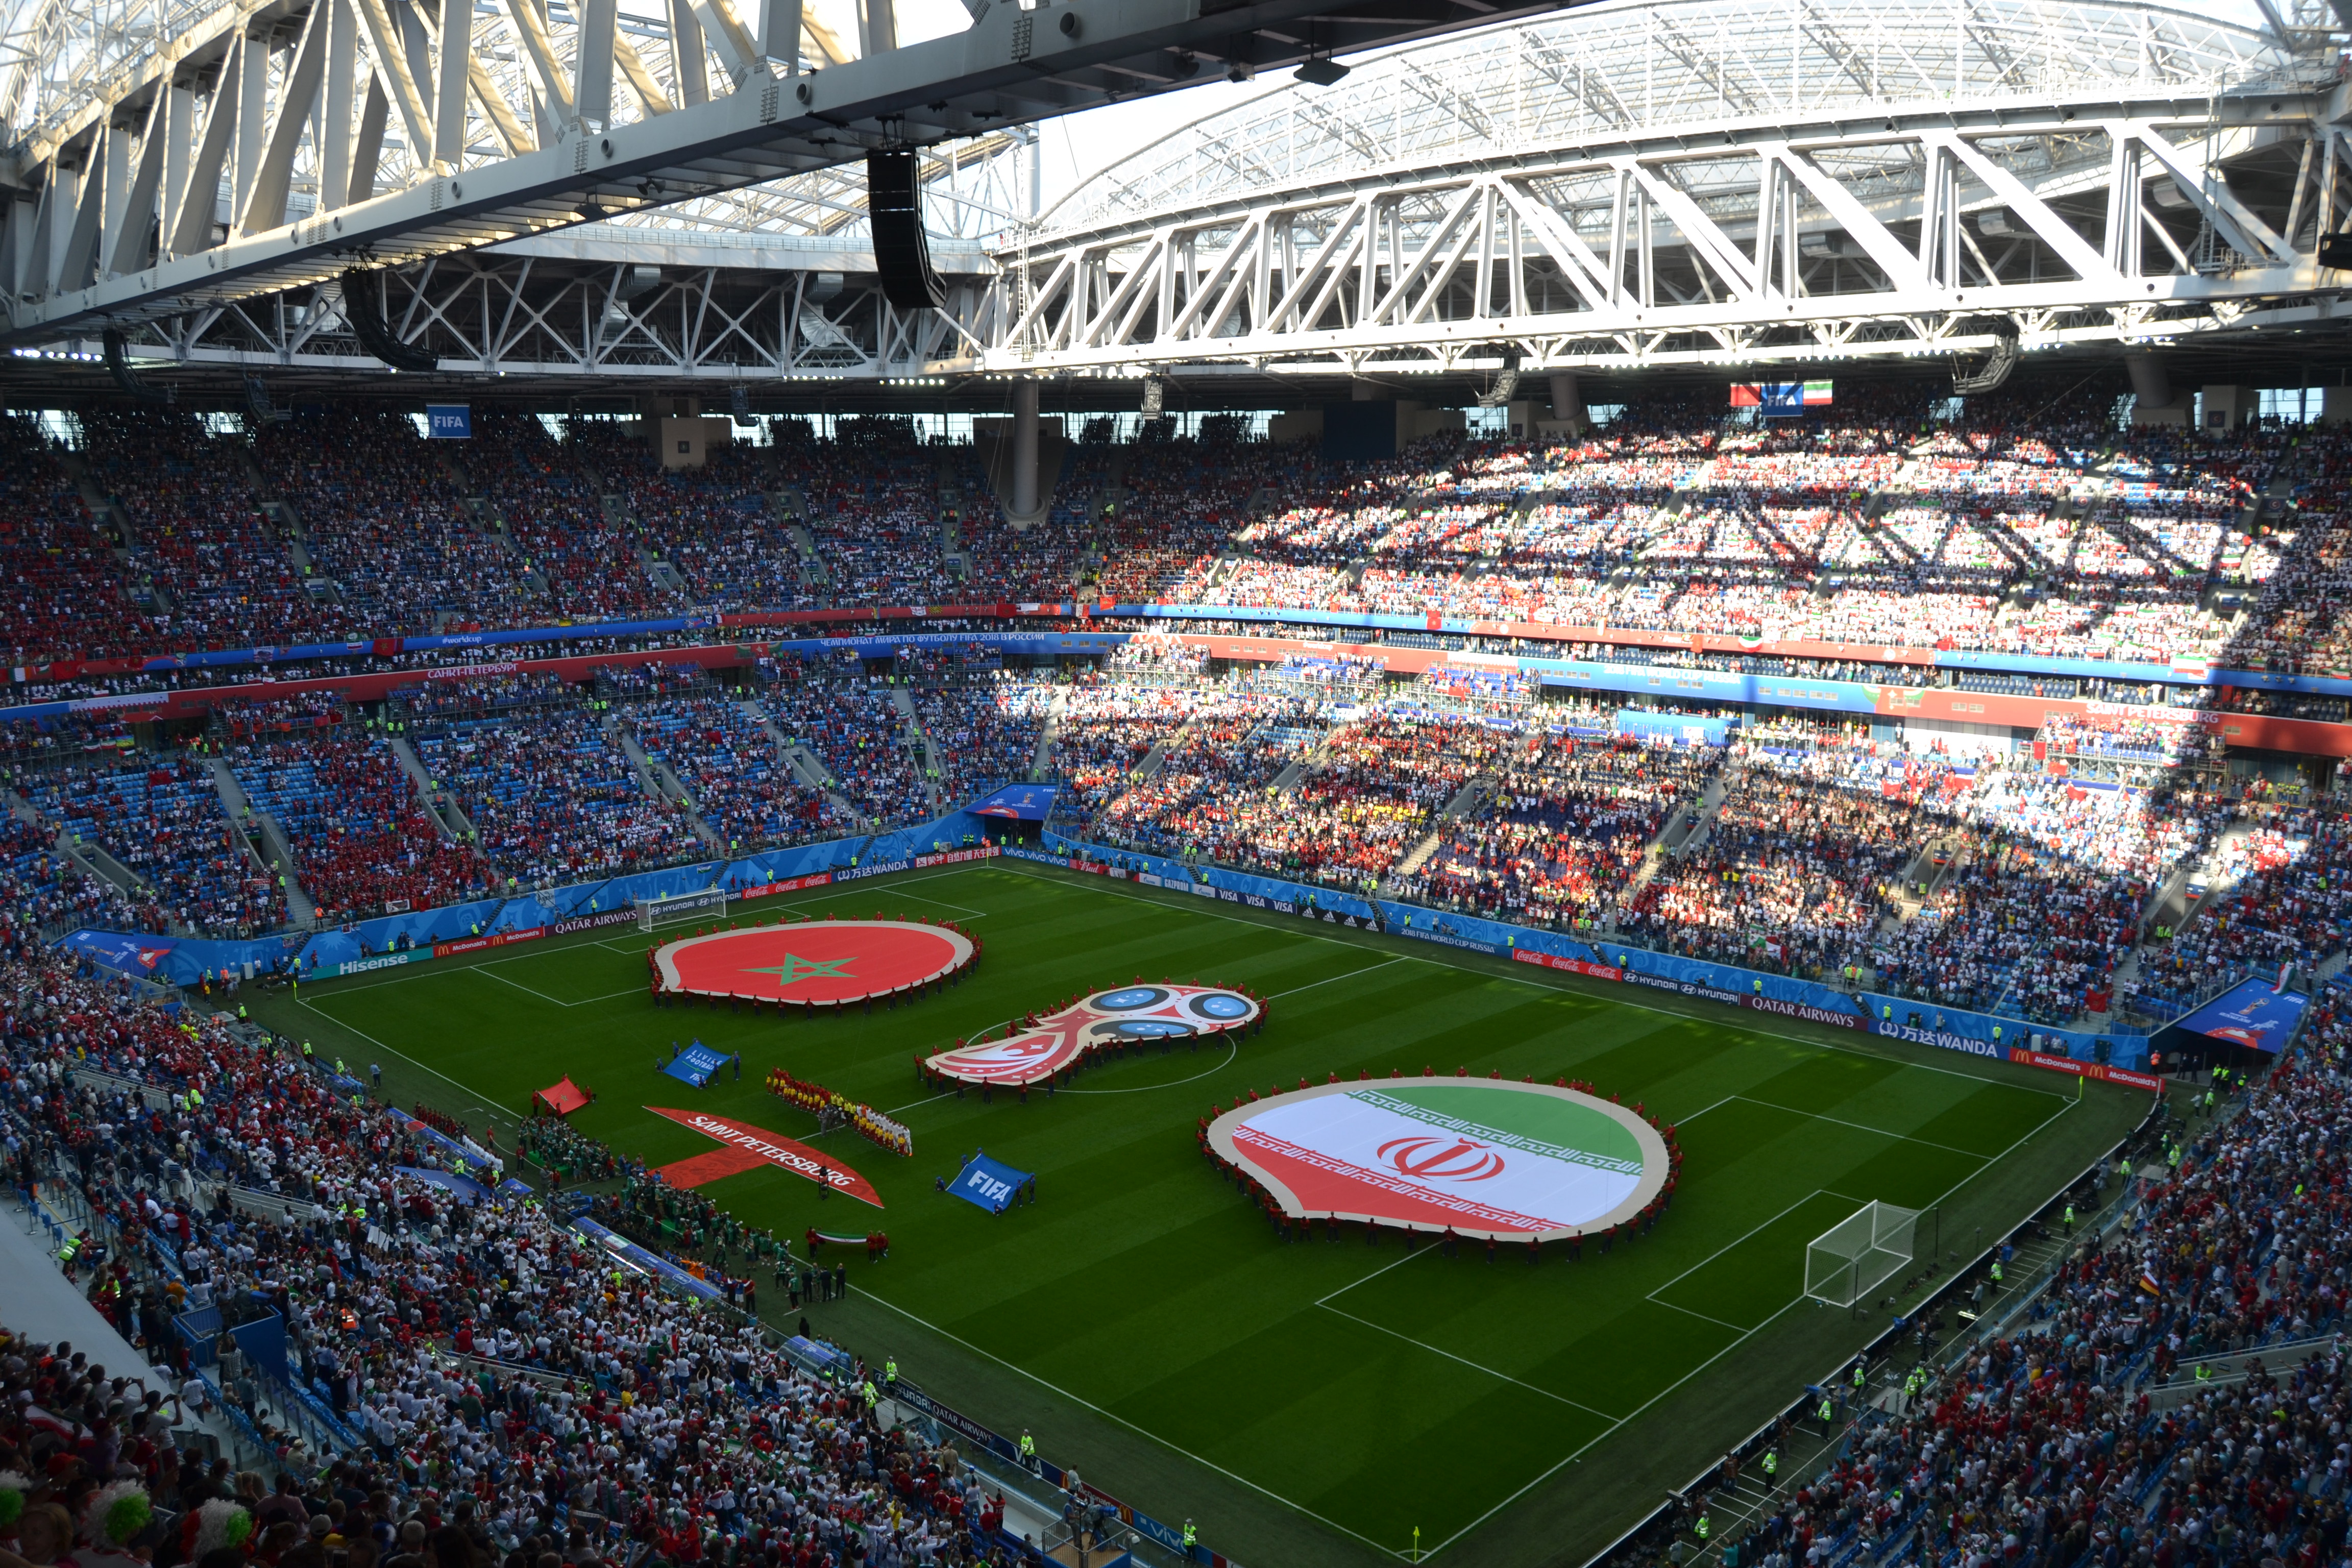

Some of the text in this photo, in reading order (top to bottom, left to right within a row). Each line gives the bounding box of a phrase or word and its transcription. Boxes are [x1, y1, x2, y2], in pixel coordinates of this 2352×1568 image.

[1768, 395, 1796, 406] FIFA
[434, 416, 463, 427] FIFA
[442, 635, 482, 645] #worldcup
[820, 637, 873, 647] ЧЕМПИОНАТ
[917, 634, 958, 643] ФУТБОЛУ
[428, 663, 519, 678] САНКТ-ПЕТЕРБУРГ
[1604, 665, 1741, 684] 2018 FIFA WORLD CUP RUSSIA
[2086, 702, 2219, 723] SAINT PETERSBURG
[872, 861, 909, 874] WANDA
[1079, 861, 1099, 873] Bud
[1164, 878, 1189, 892] GAZPROM
[663, 900, 695, 913] HYUNDAI
[1219, 890, 1238, 902] VISA
[1245, 895, 1265, 908] VISA
[1273, 900, 1293, 913] VISA
[555, 910, 637, 934] QATAR AIRWAYS
[452, 930, 539, 951] McDonald's McDonald's
[1401, 928, 1496, 953] 2018 FIFA WORLD CUP RUSSIA
[340, 953, 408, 975] Hisense
[1639, 976, 1737, 1002] HYUNDAI HYUNDAI
[2283, 995, 2305, 1004] FIFA
[1752, 997, 1854, 1027] QATAR AIRWAYS
[1902, 1026, 1998, 1057] 万达 WANDA
[685, 1055, 715, 1070] FOOTBALL
[2035, 1056, 2157, 1087] McDonald's McDonald's
[688, 1116, 855, 1186] SAINT PETERSBURG
[967, 1170, 1012, 1202] FIFA
[933, 1404, 992, 1440] QATAR AIRWAYS
